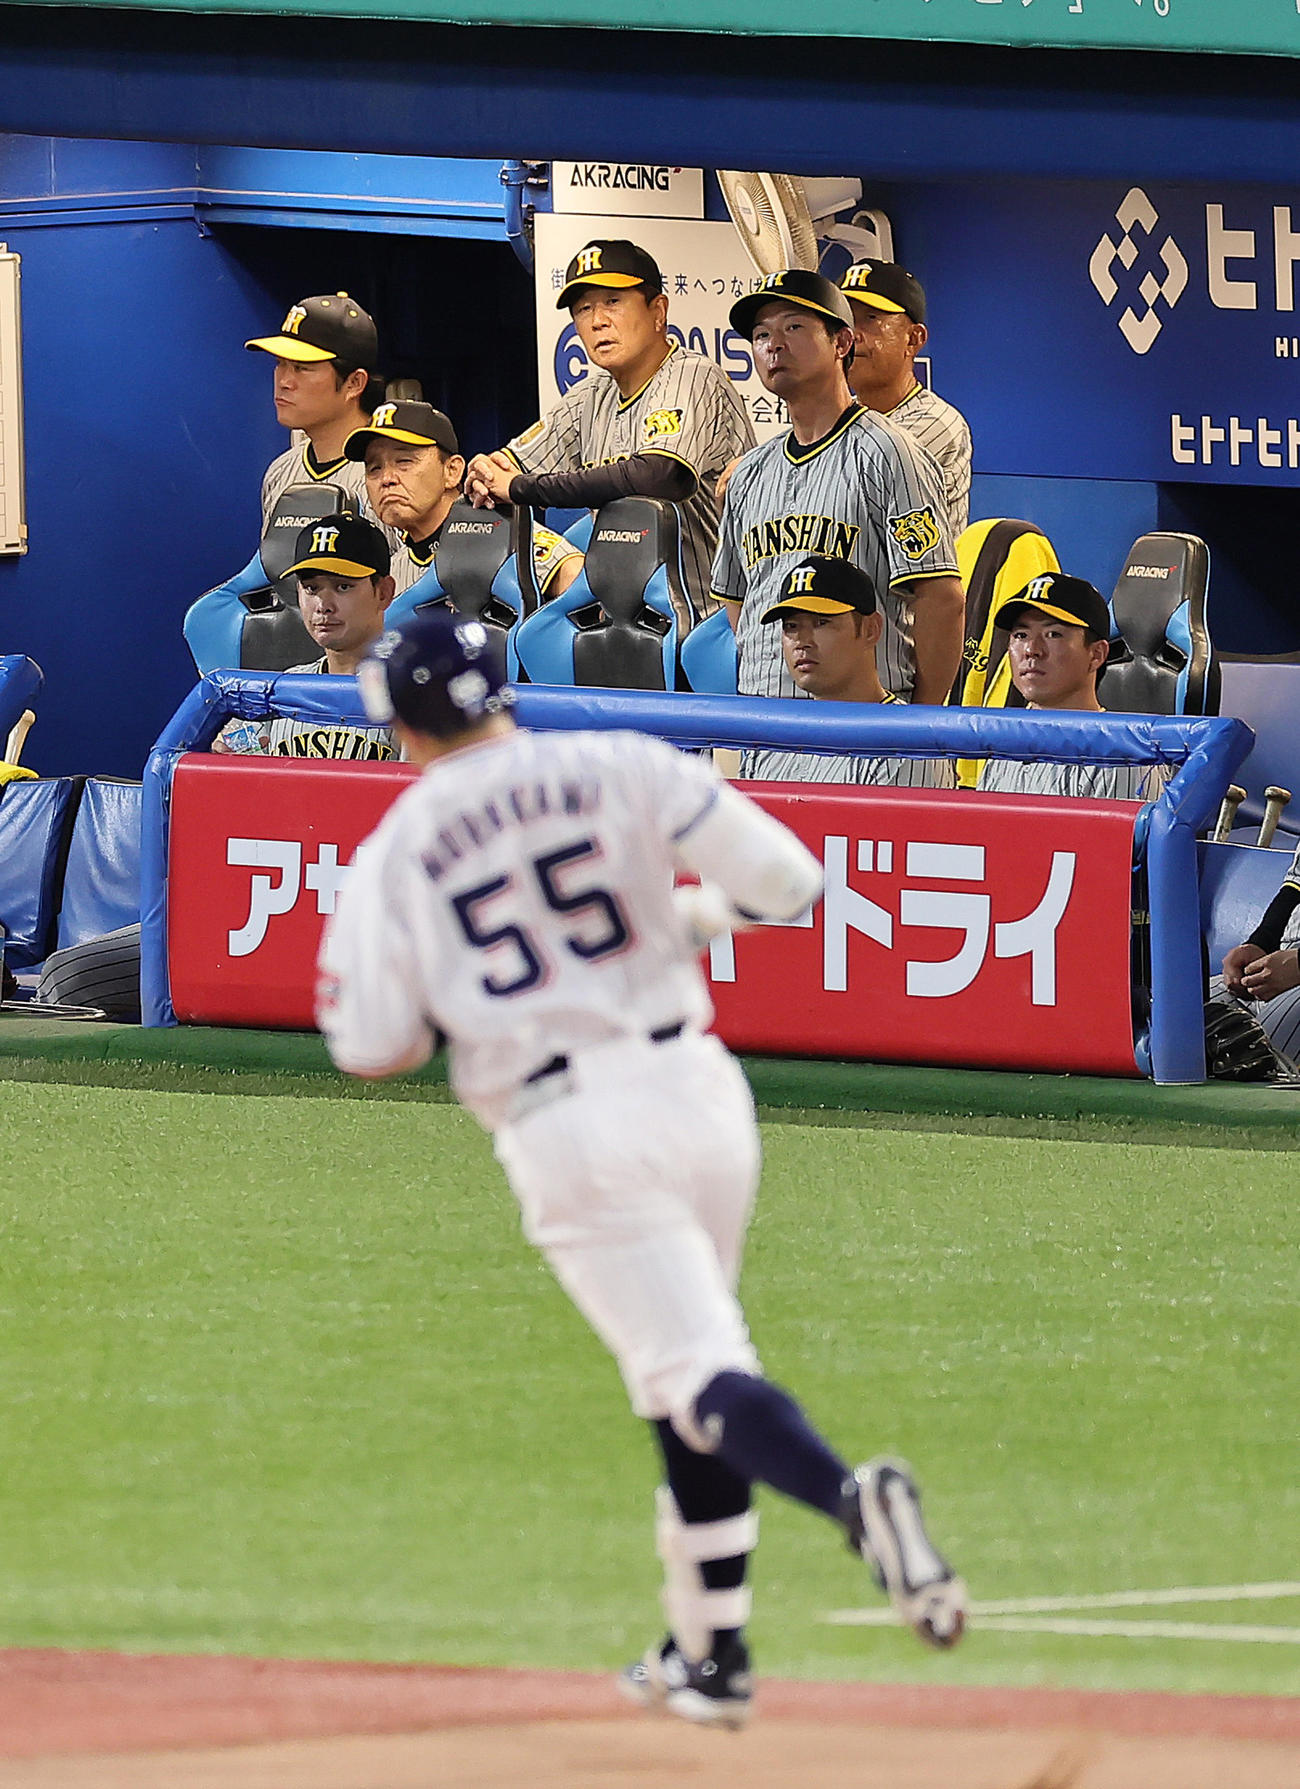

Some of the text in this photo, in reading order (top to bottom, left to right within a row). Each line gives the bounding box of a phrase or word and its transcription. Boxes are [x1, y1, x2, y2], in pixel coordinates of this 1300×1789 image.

[570, 164, 670, 191] AKRACING
[447, 521, 495, 535] AKRACING
[596, 528, 641, 543] AKRACING
[1126, 565, 1169, 579] AKRACING
[270, 729, 393, 760] ANSHIN
[449, 839, 634, 999] 55
